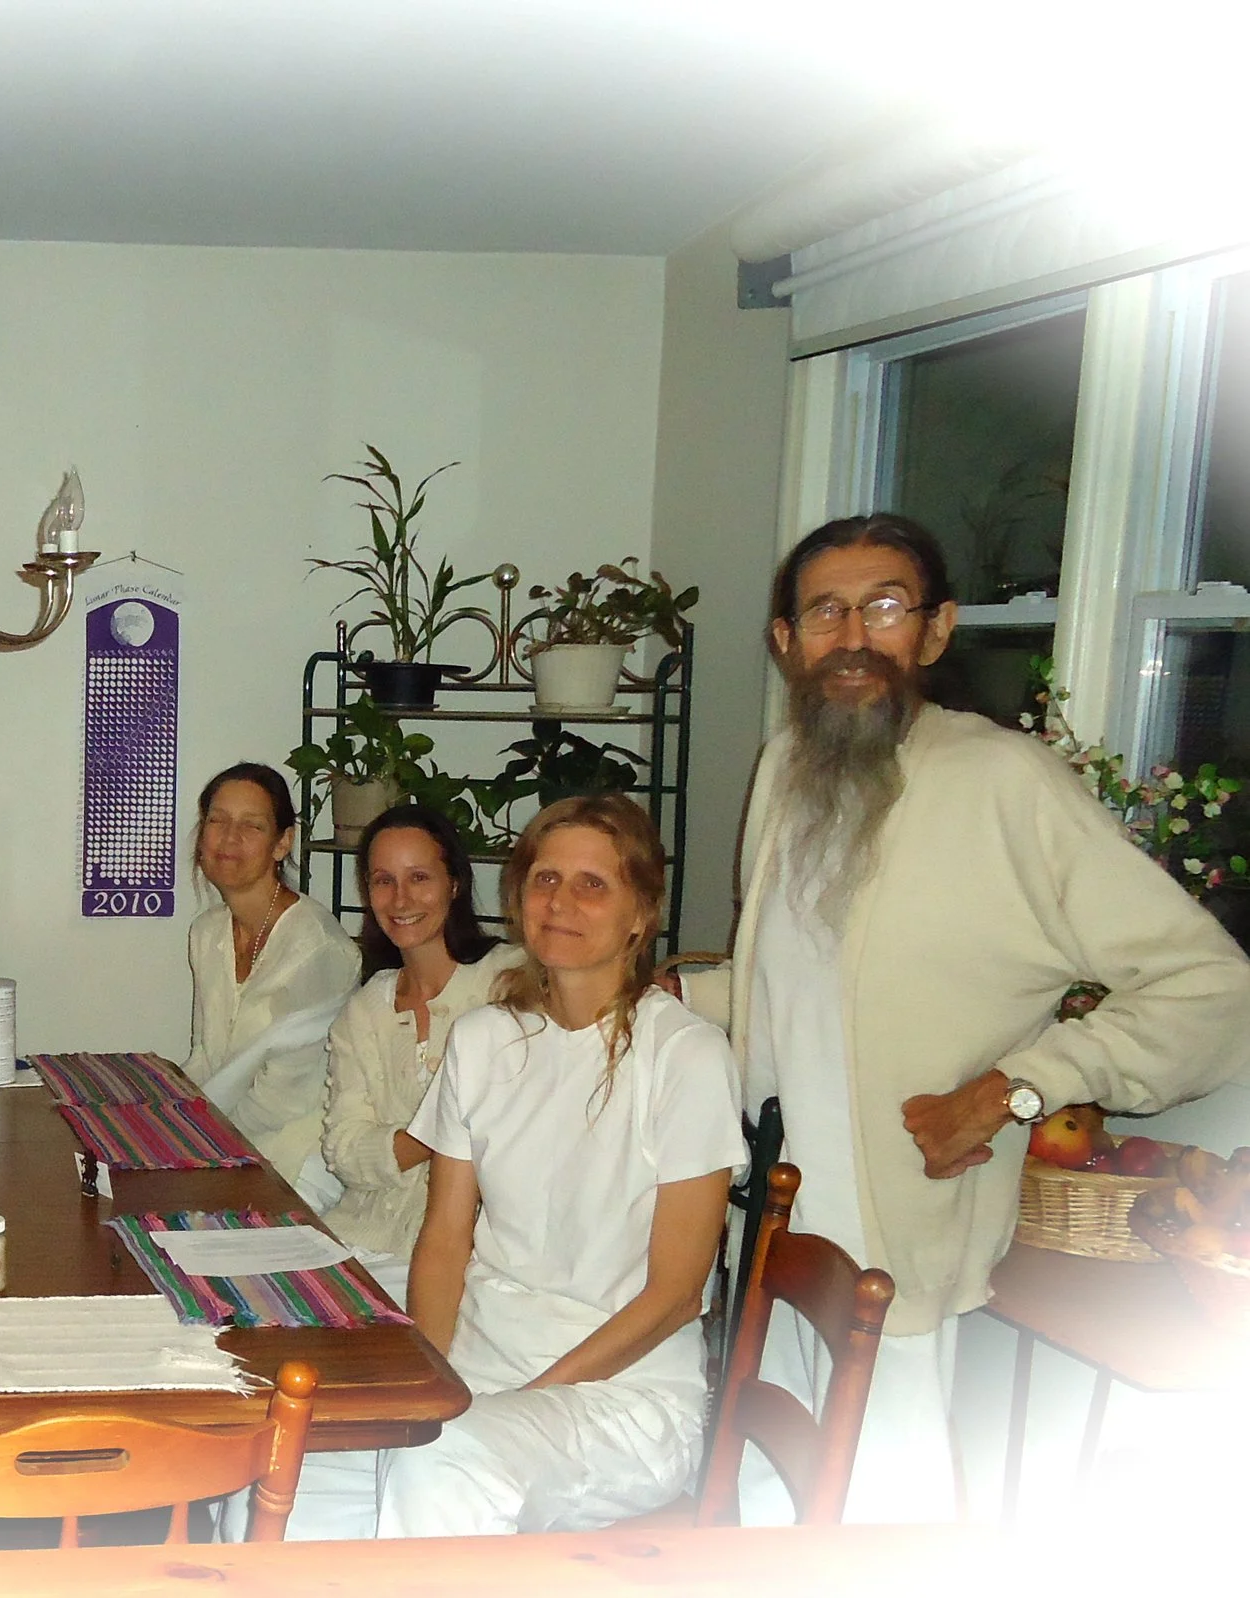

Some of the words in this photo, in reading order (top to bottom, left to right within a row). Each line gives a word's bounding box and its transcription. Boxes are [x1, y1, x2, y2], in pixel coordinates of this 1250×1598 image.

[85, 590, 110, 606] Lunar
[111, 584, 139, 594] Phase
[142, 584, 181, 606] Calendar
[92, 892, 162, 914] 2010
